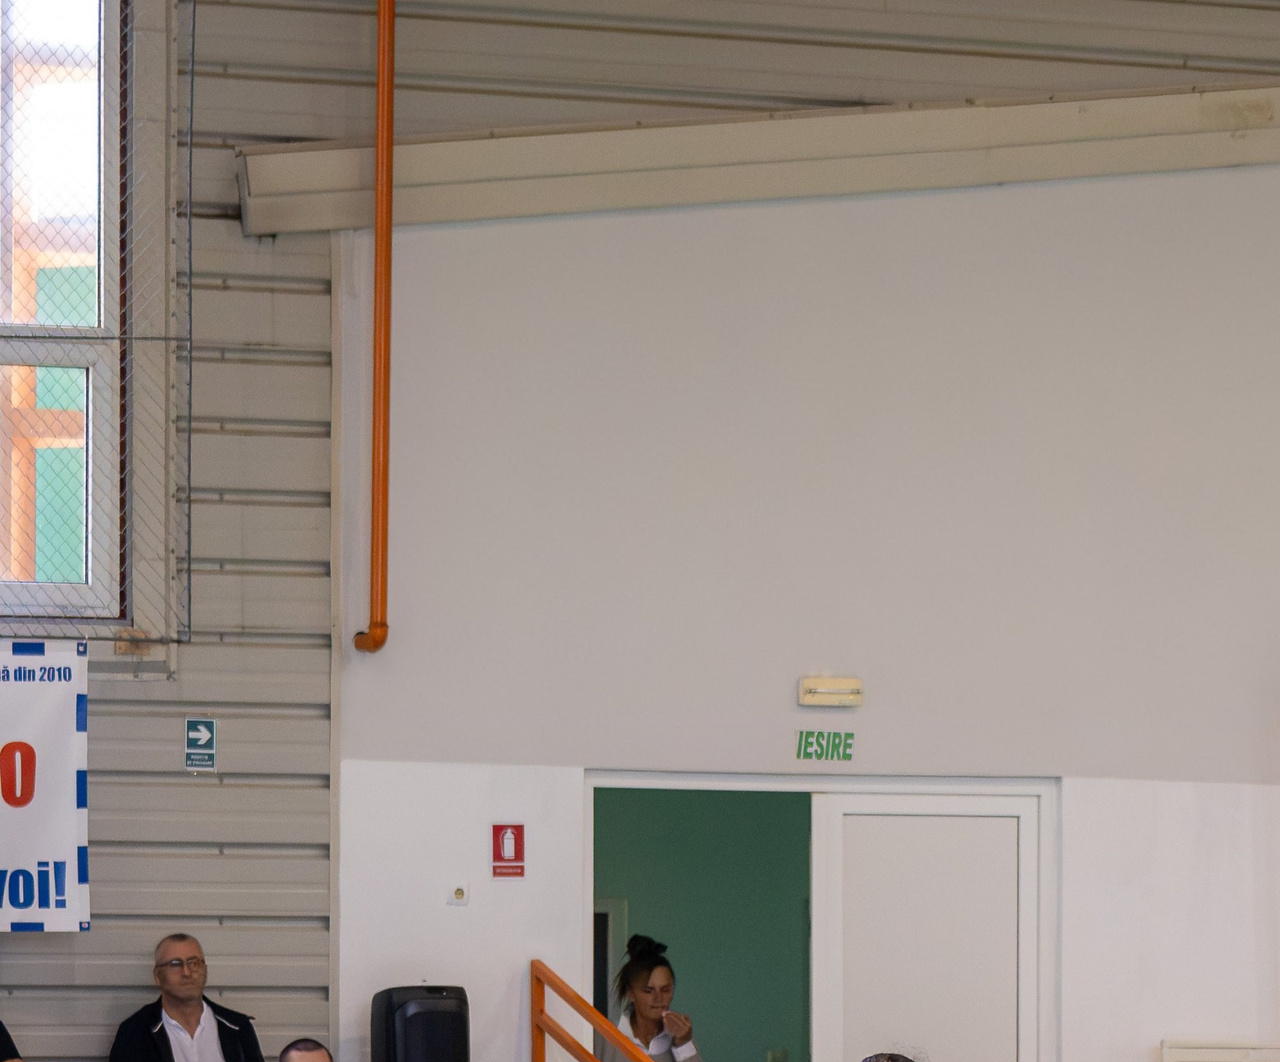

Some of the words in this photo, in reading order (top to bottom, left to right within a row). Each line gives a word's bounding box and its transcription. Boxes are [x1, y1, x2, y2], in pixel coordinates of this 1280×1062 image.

[14, 666, 36, 682] din
[39, 666, 72, 682] 2010
[796, 730, 855, 761] IESIRE
